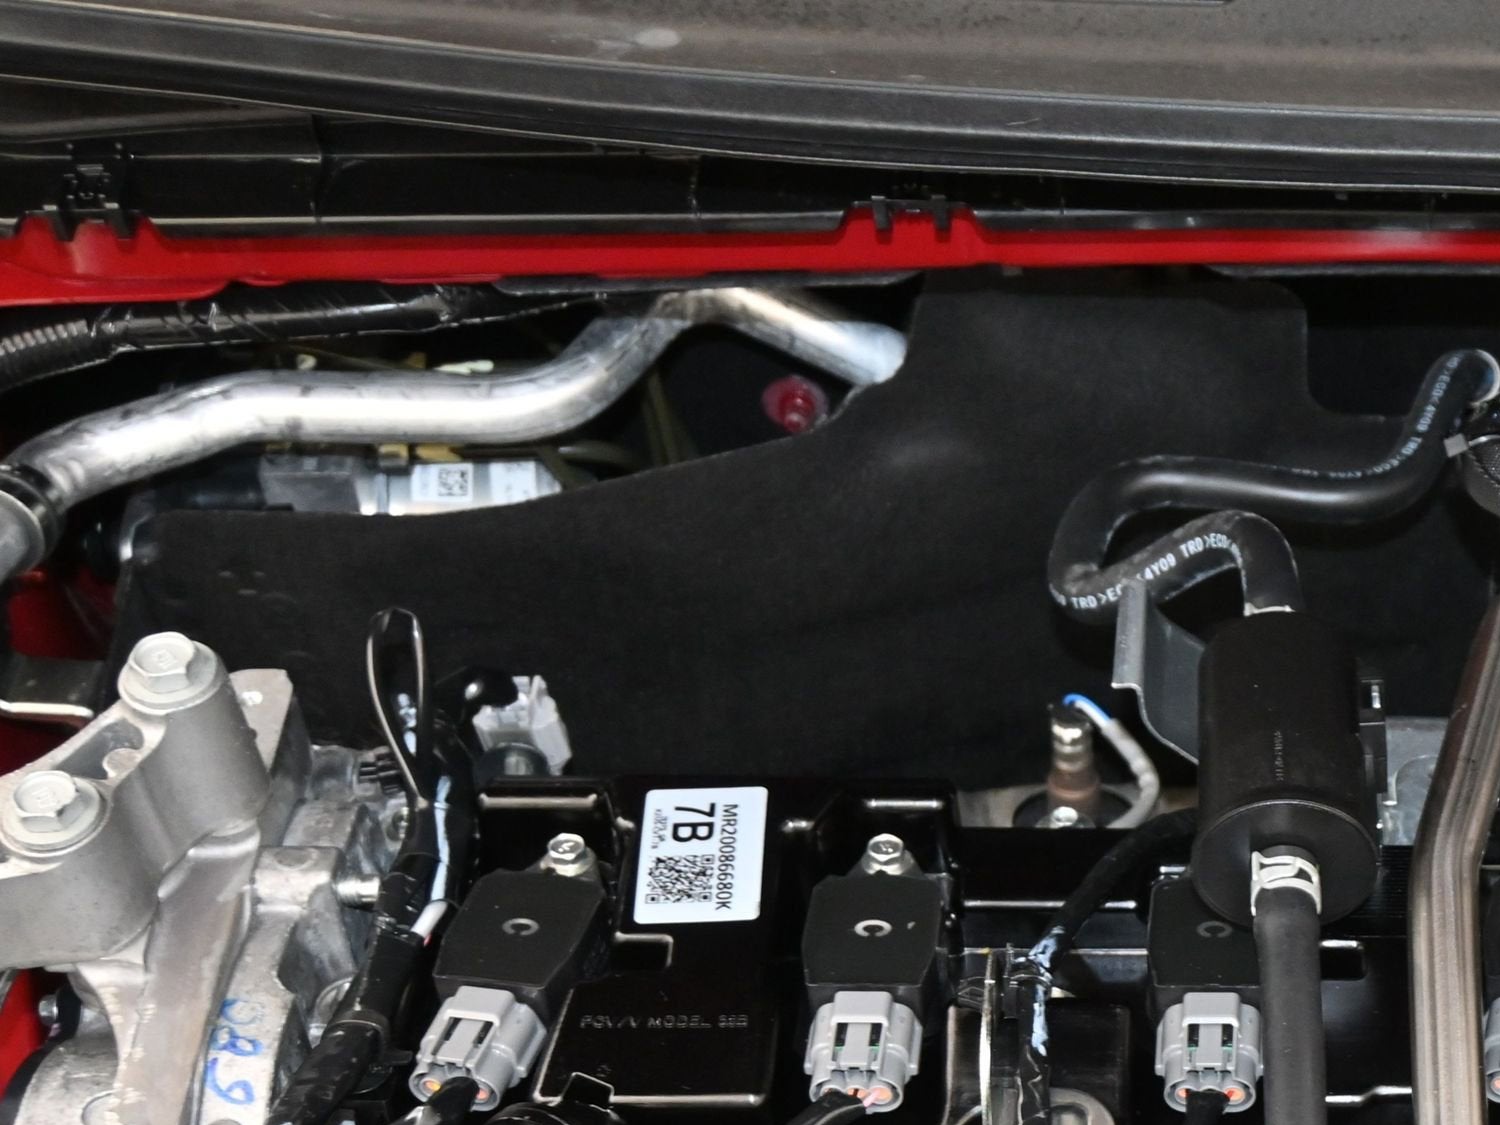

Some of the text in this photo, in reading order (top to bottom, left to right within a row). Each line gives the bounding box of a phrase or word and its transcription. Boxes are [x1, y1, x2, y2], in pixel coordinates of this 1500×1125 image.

[671, 801, 716, 843] 7B
[715, 803, 739, 911] MR20086680K
[647, 1014, 712, 1029] MODEL
